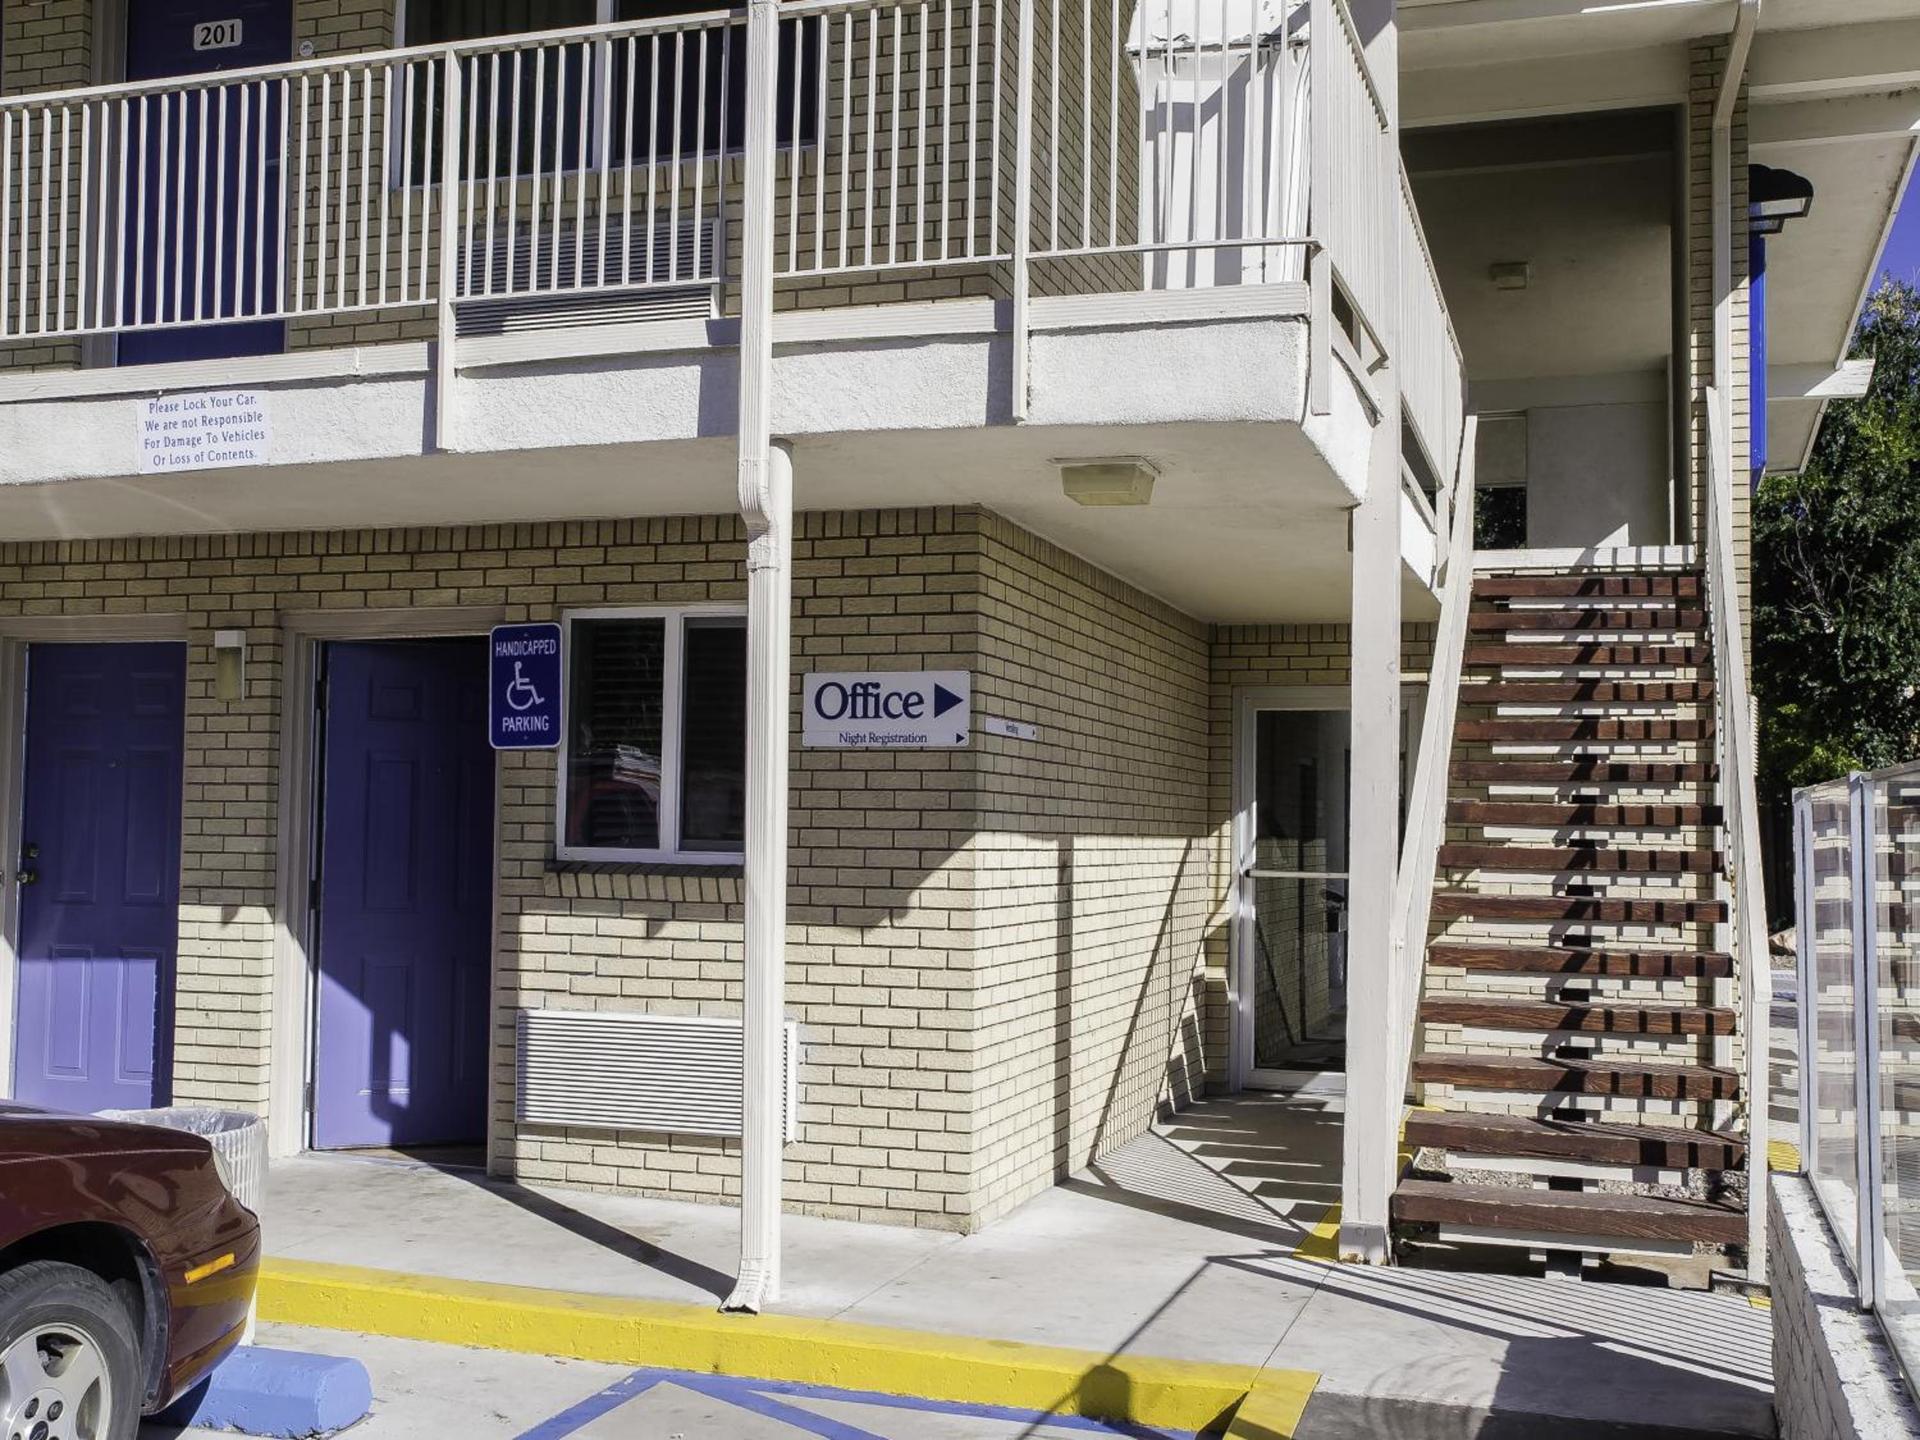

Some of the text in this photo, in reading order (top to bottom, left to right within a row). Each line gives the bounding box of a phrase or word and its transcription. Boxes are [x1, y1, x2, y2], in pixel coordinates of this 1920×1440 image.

[200, 23, 235, 46] 201
[149, 394, 257, 414] Please Lock Your Car.
[145, 411, 263, 432] We are not Responsible
[144, 429, 265, 449] For Damage To Vehicles
[153, 449, 257, 466] Or Loss of Contents.
[495, 639, 557, 657] HANDICAPPED
[814, 682, 925, 720] Office
[502, 715, 549, 732] PARKING
[839, 731, 928, 746] Night Registration
